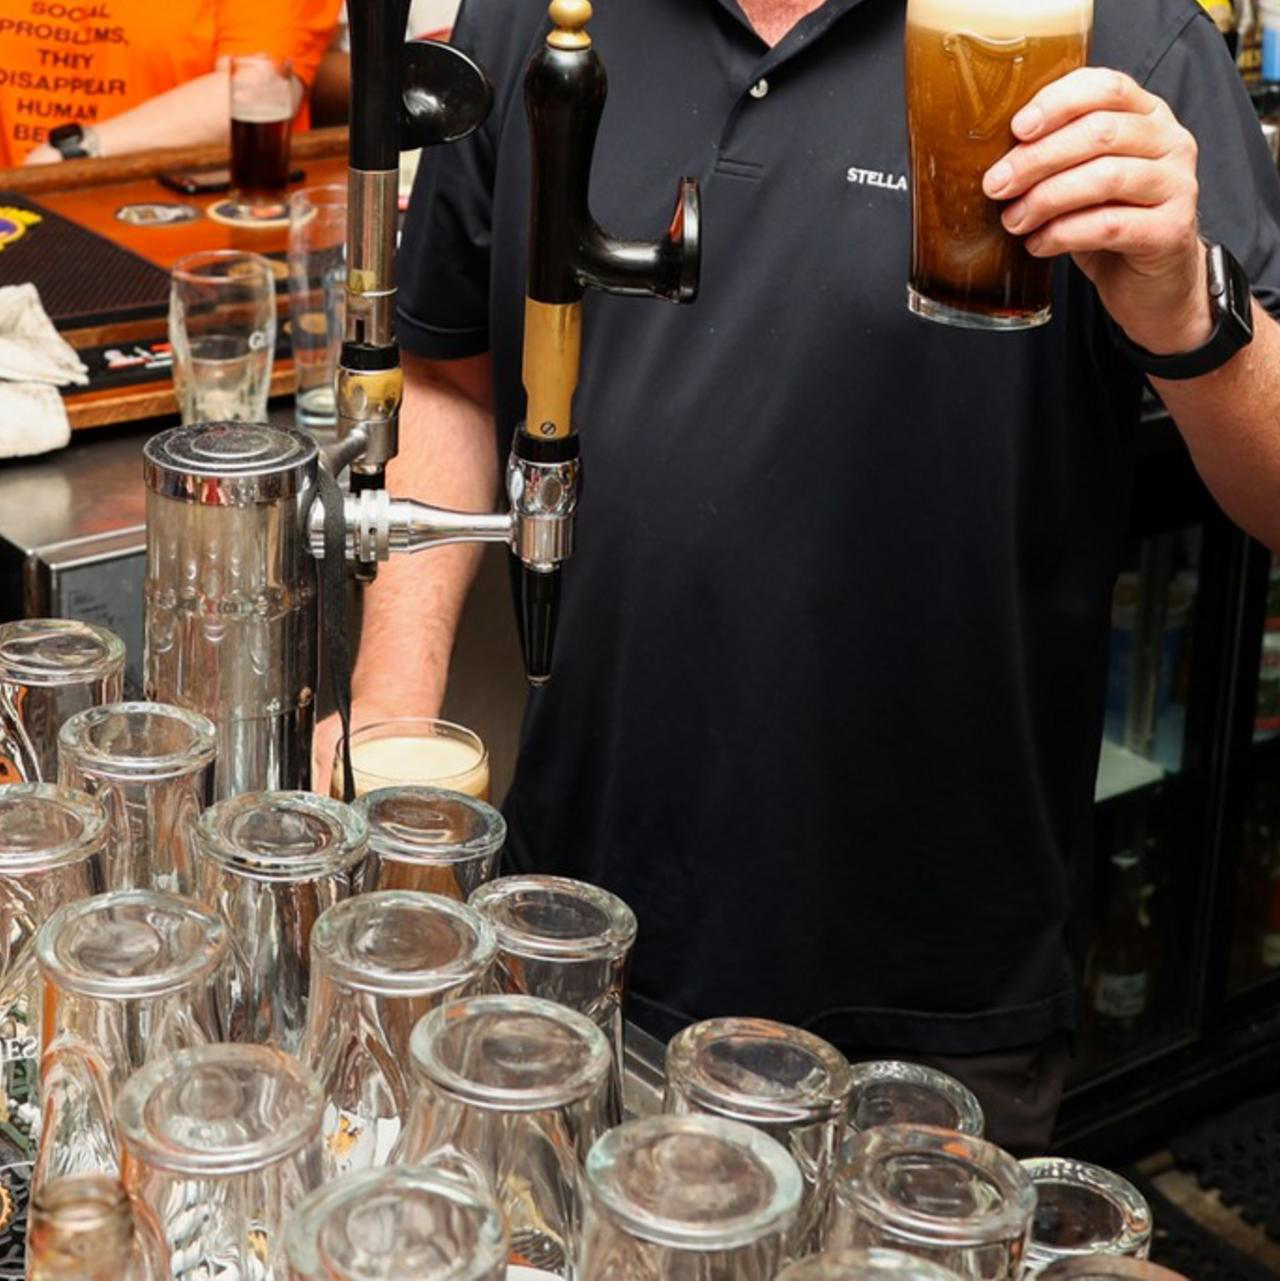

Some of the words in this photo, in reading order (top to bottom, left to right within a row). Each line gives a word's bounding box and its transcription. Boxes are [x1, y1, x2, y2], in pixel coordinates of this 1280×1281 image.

[31, 1, 110, 22] SOCIAL
[38, 48, 94, 70] THEY
[16, 97, 98, 120] HUMAN
[847, 167, 908, 191] STELLA
